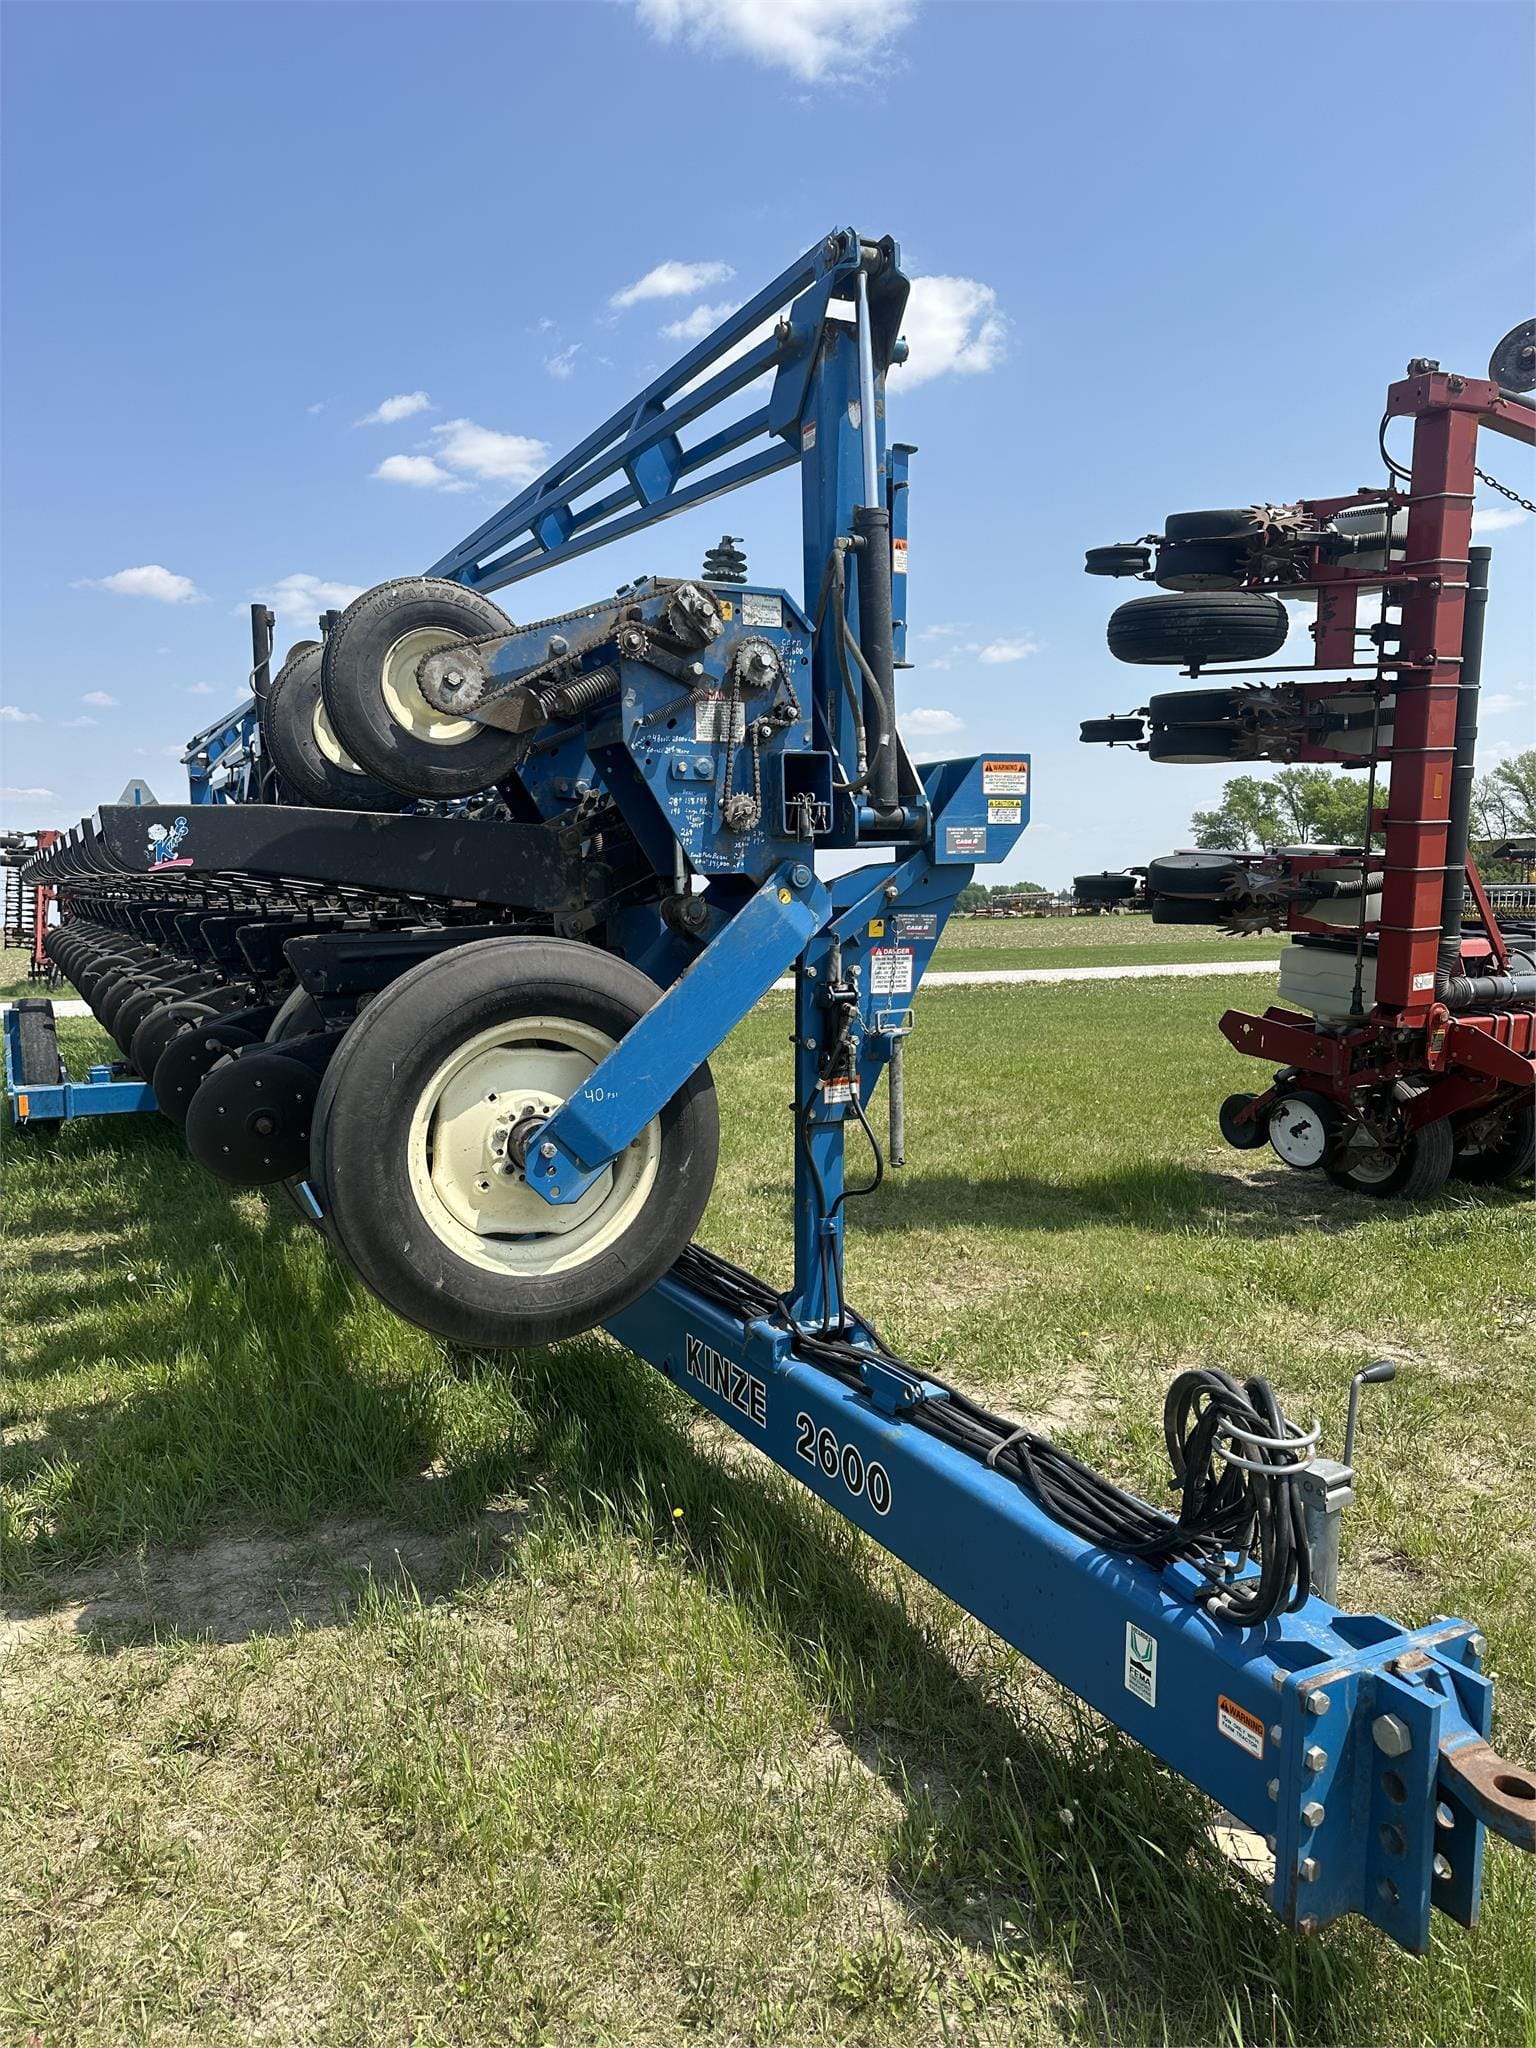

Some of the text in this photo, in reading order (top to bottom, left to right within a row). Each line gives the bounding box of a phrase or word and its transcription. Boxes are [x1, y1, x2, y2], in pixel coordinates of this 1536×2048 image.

[425, 587, 490, 619] TRAIL
[584, 1087, 604, 1103] 40
[686, 1332, 767, 1430] KINZE
[796, 1411, 892, 1516] 2600
[1129, 1666, 1151, 1686] FEMA
[1222, 1720, 1258, 1749] FARM TRACTOR
[1229, 1704, 1263, 1736] WARNING
